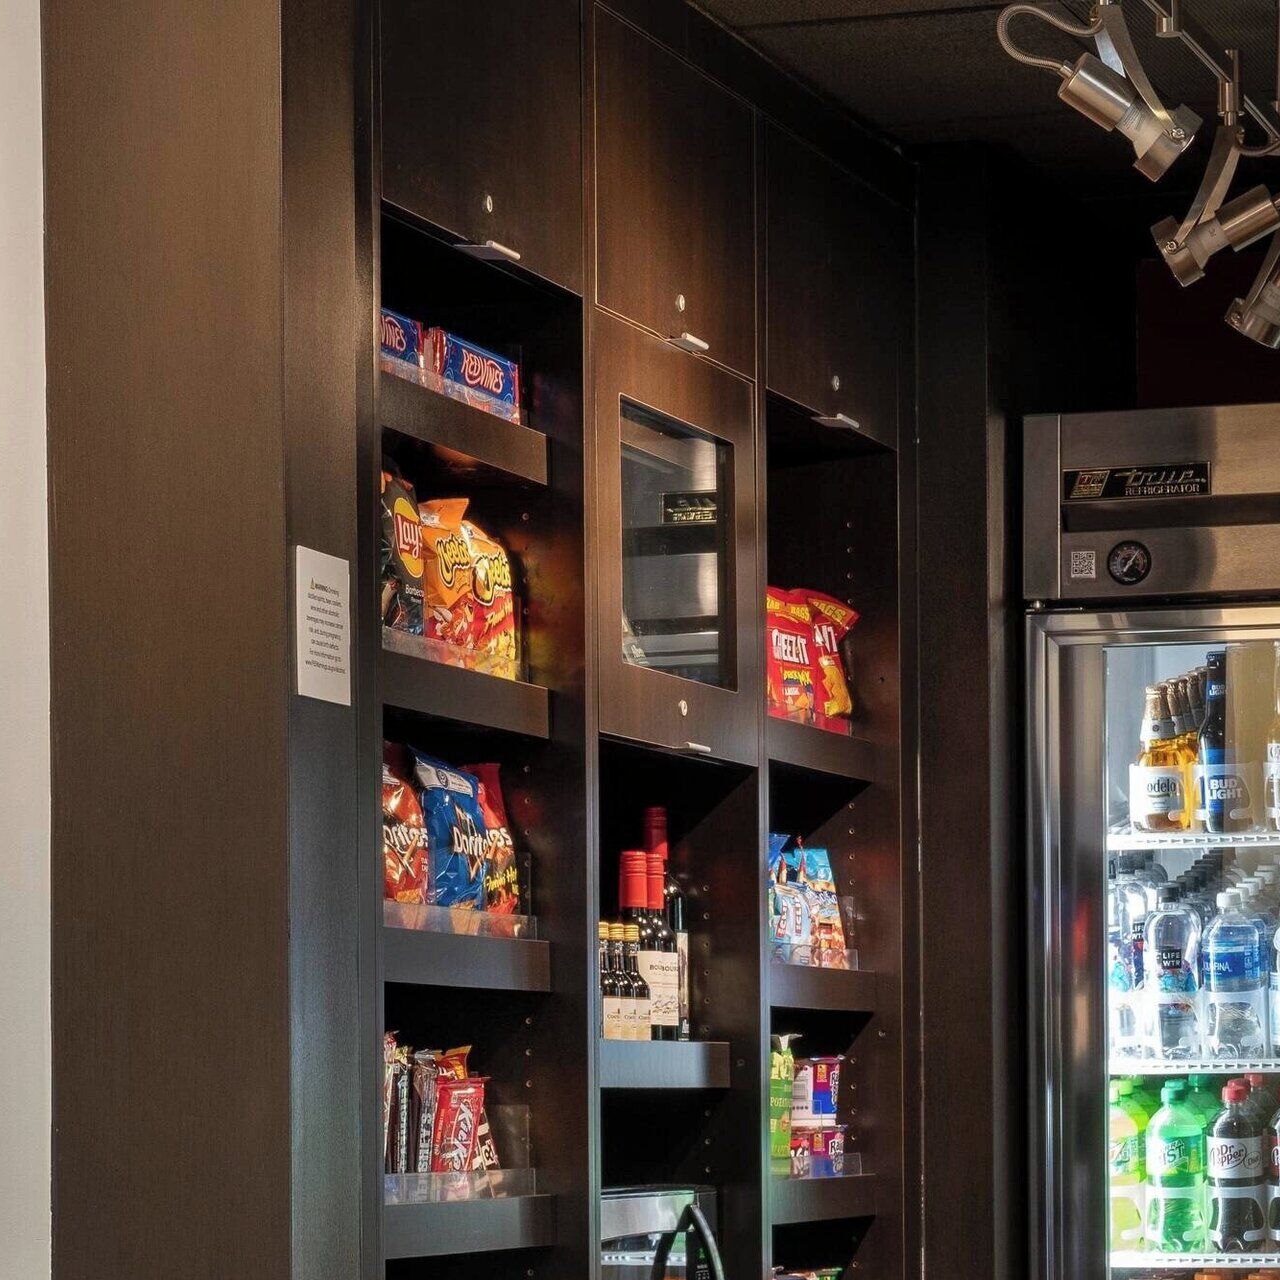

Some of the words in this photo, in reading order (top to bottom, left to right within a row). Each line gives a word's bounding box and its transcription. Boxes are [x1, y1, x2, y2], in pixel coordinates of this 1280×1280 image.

[1114, 469, 1203, 486] true
[1125, 484, 1200, 496] REFRIGERATOR
[1147, 779, 1176, 793] odelo
[1210, 778, 1238, 789] BUD
[1208, 787, 1244, 800] LIGHT
[1162, 951, 1181, 959] LIFE
[1220, 1144, 1235, 1154] Dr
